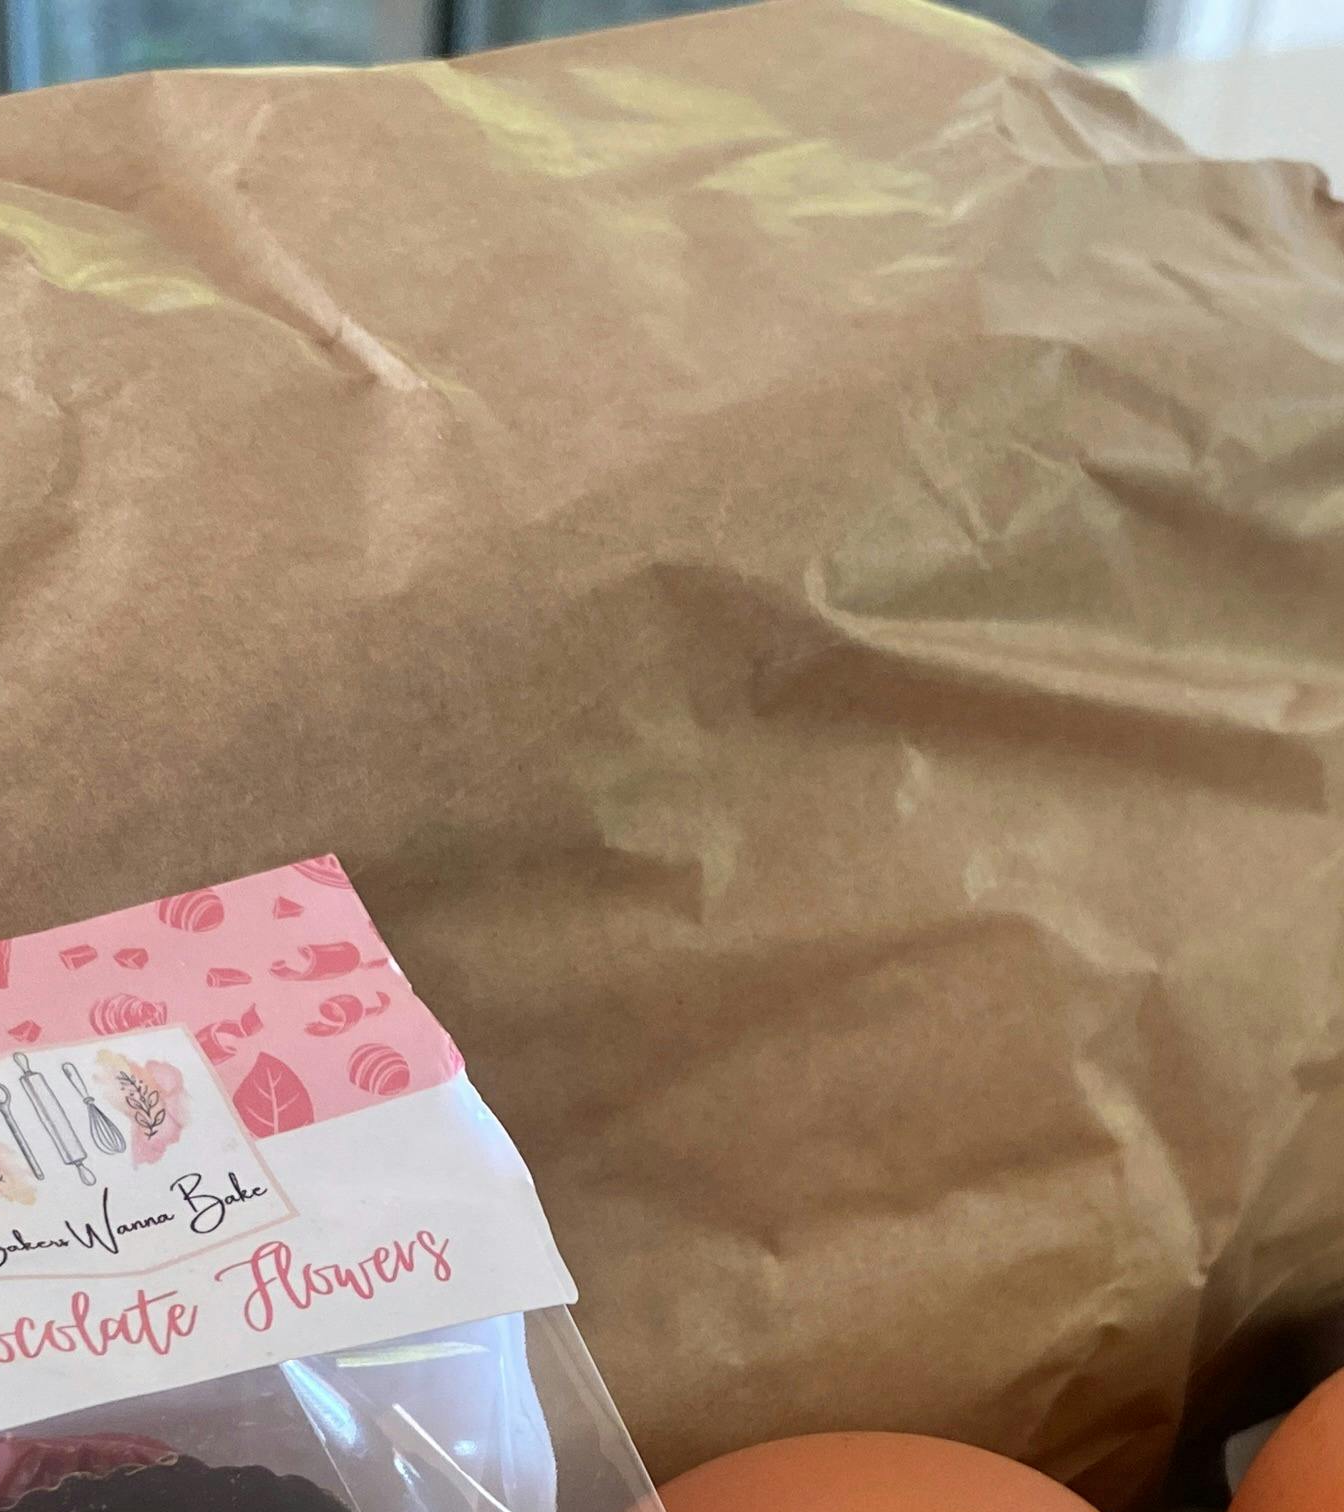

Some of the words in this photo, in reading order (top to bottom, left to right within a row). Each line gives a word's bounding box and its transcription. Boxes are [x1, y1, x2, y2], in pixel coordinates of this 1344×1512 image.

[65, 1187, 175, 1255] Wanna
[170, 1171, 268, 1234] Bake
[214, 1227, 453, 1333] Flowers
